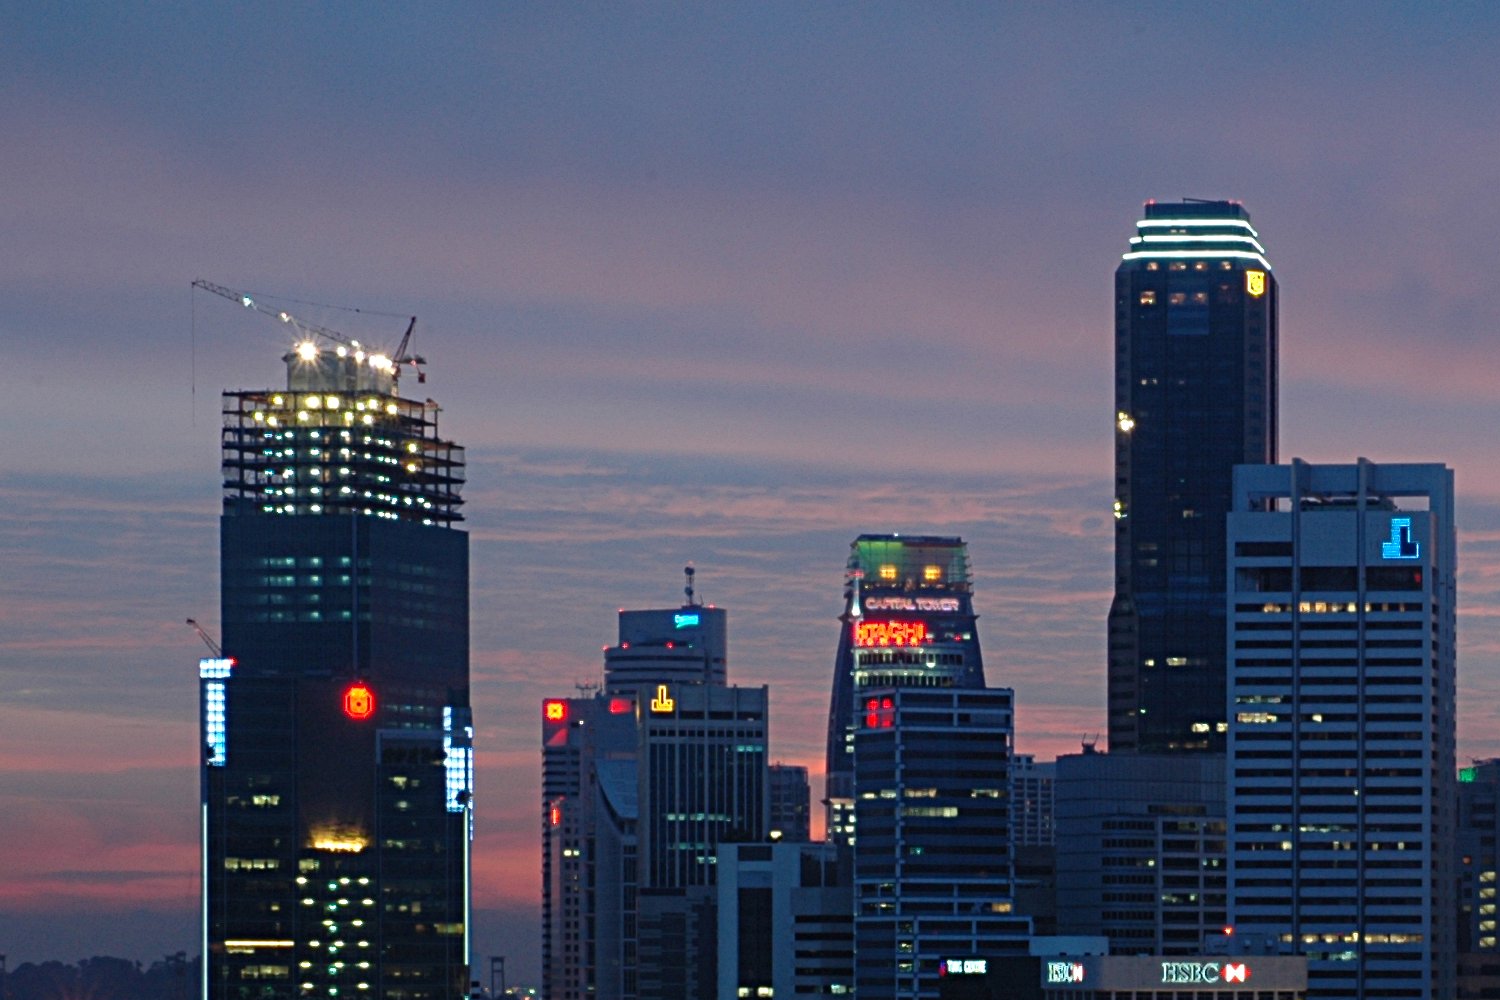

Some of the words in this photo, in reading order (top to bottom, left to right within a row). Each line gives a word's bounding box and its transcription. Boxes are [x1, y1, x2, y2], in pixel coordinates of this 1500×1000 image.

[865, 597, 915, 609] CAPITAL
[916, 598, 960, 611] TOWER
[855, 620, 925, 639] HITACHI
[1161, 962, 1219, 984] HSBC
